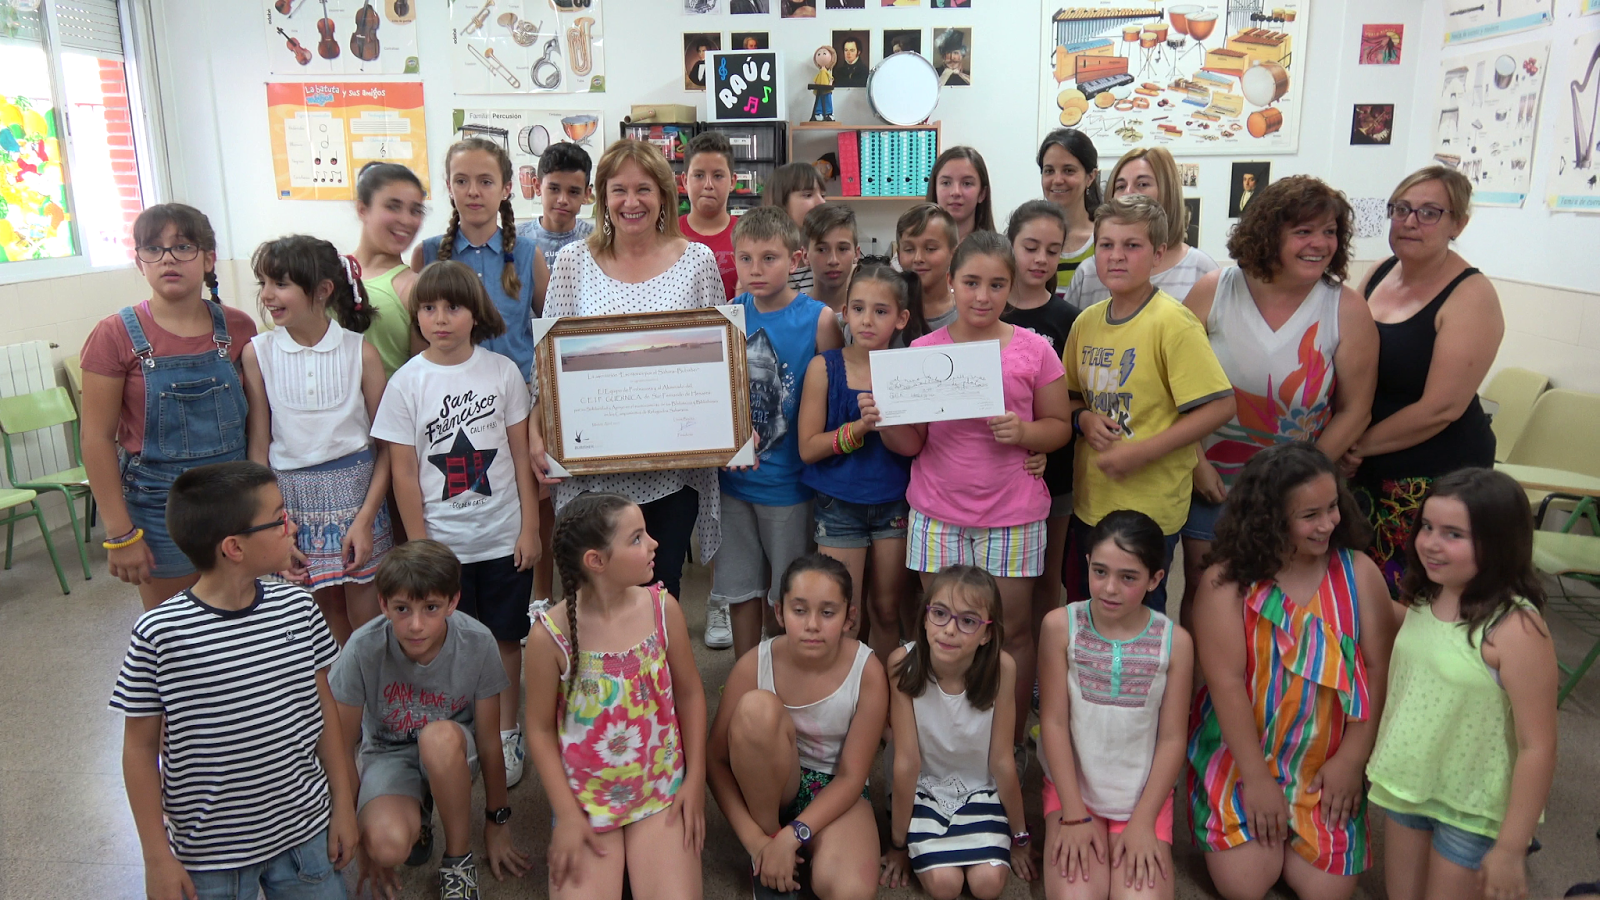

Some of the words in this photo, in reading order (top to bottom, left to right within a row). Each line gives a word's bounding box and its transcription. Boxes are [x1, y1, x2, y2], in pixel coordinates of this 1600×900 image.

[305, 86, 315, 94] La
[315, 84, 340, 94] batuta
[342, 90, 347, 98] y
[348, 89, 361, 97] sus
[362, 87, 386, 99] amigos
[719, 56, 771, 109] RAÚL
[492, 111, 522, 120] Percusión
[1082, 346, 1114, 368] THE
[440, 389, 478, 418] San
[425, 394, 498, 443] Francisco
[383, 681, 414, 711] CLARK
[419, 688, 446, 709] KENT
